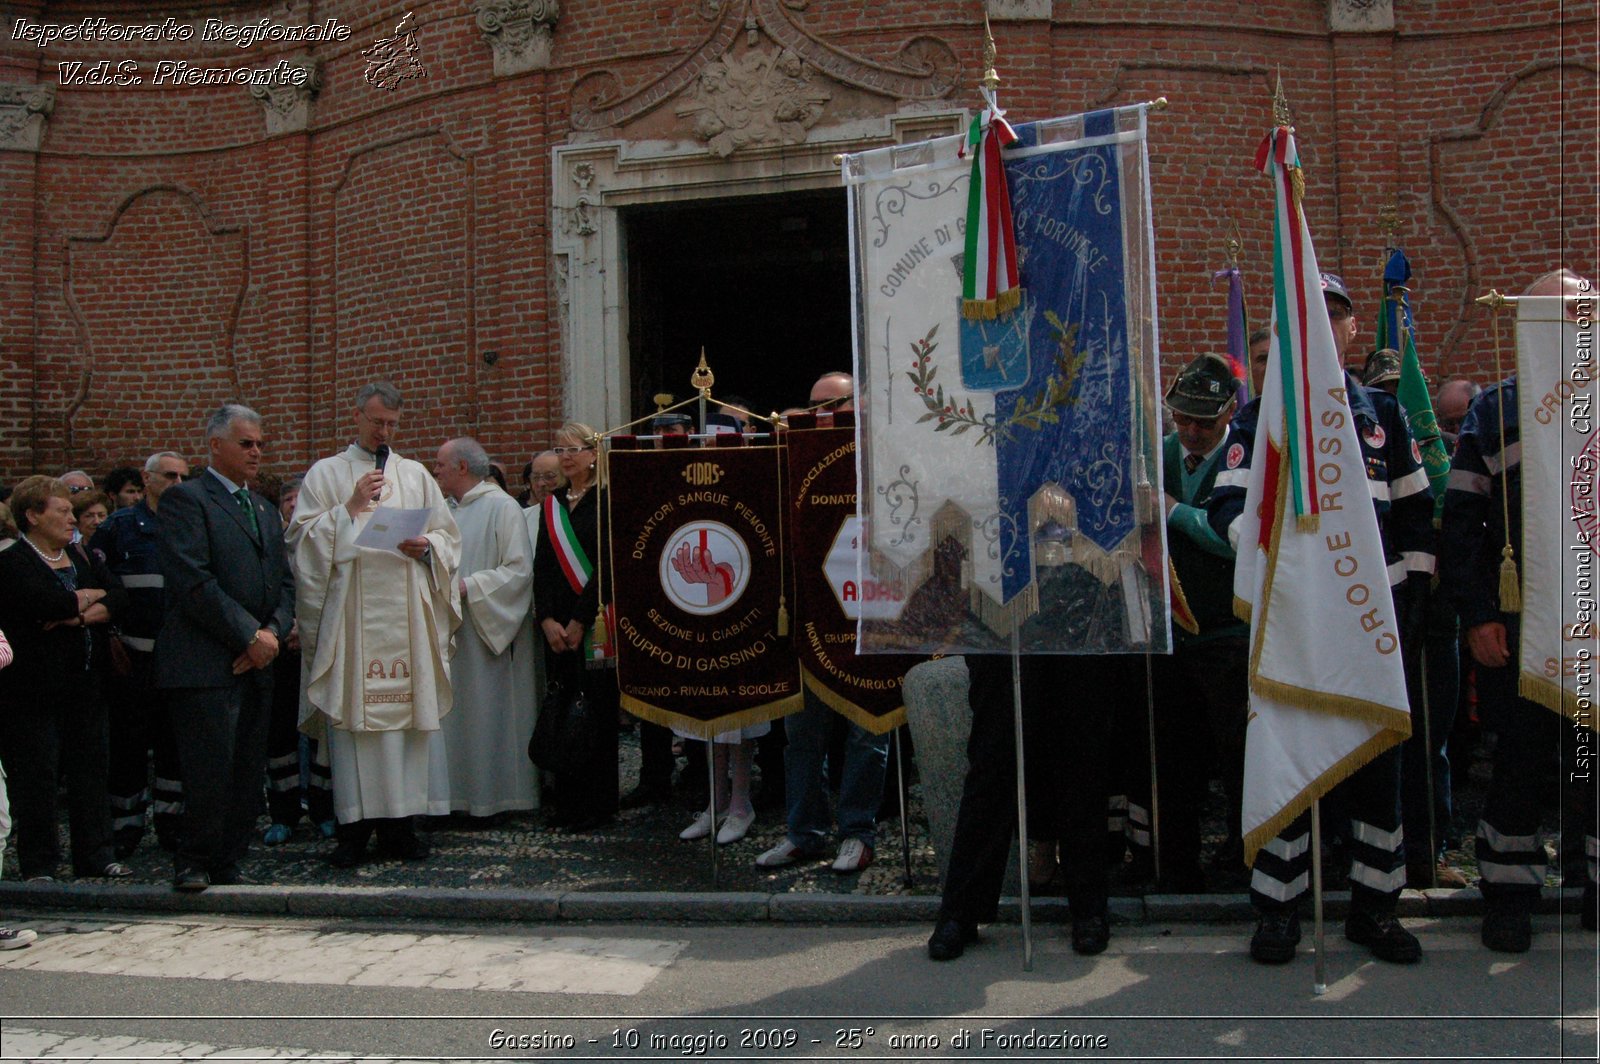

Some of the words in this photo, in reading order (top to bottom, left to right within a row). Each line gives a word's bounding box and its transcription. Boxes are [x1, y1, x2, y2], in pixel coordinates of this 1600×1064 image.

[880, 237, 934, 298] COMUNE
[1034, 213, 1108, 274] TORINESE
[684, 462, 721, 485] FIDAS
[1318, 387, 1346, 512] ROSSA
[632, 502, 674, 559] DONATORI
[678, 491, 730, 506] SANGUE
[734, 501, 776, 558] PIEMONTE
[811, 494, 858, 505] DONATO
[1326, 531, 1398, 655] CROCE
[619, 616, 673, 664] GRUPPO
[676, 655, 691, 670] DI
[696, 640, 766, 671] GASSINO
[647, 608, 693, 641] SEZIONE
[697, 633, 708, 643] U.
[712, 608, 762, 641] CIABATTI
[824, 634, 857, 644] GRUPP
[805, 621, 838, 675] MONTALDO
[838, 671, 896, 690] PAVAROLO
[680, 685, 728, 697] RIVALBA
[739, 681, 790, 696] SCIOLZE
